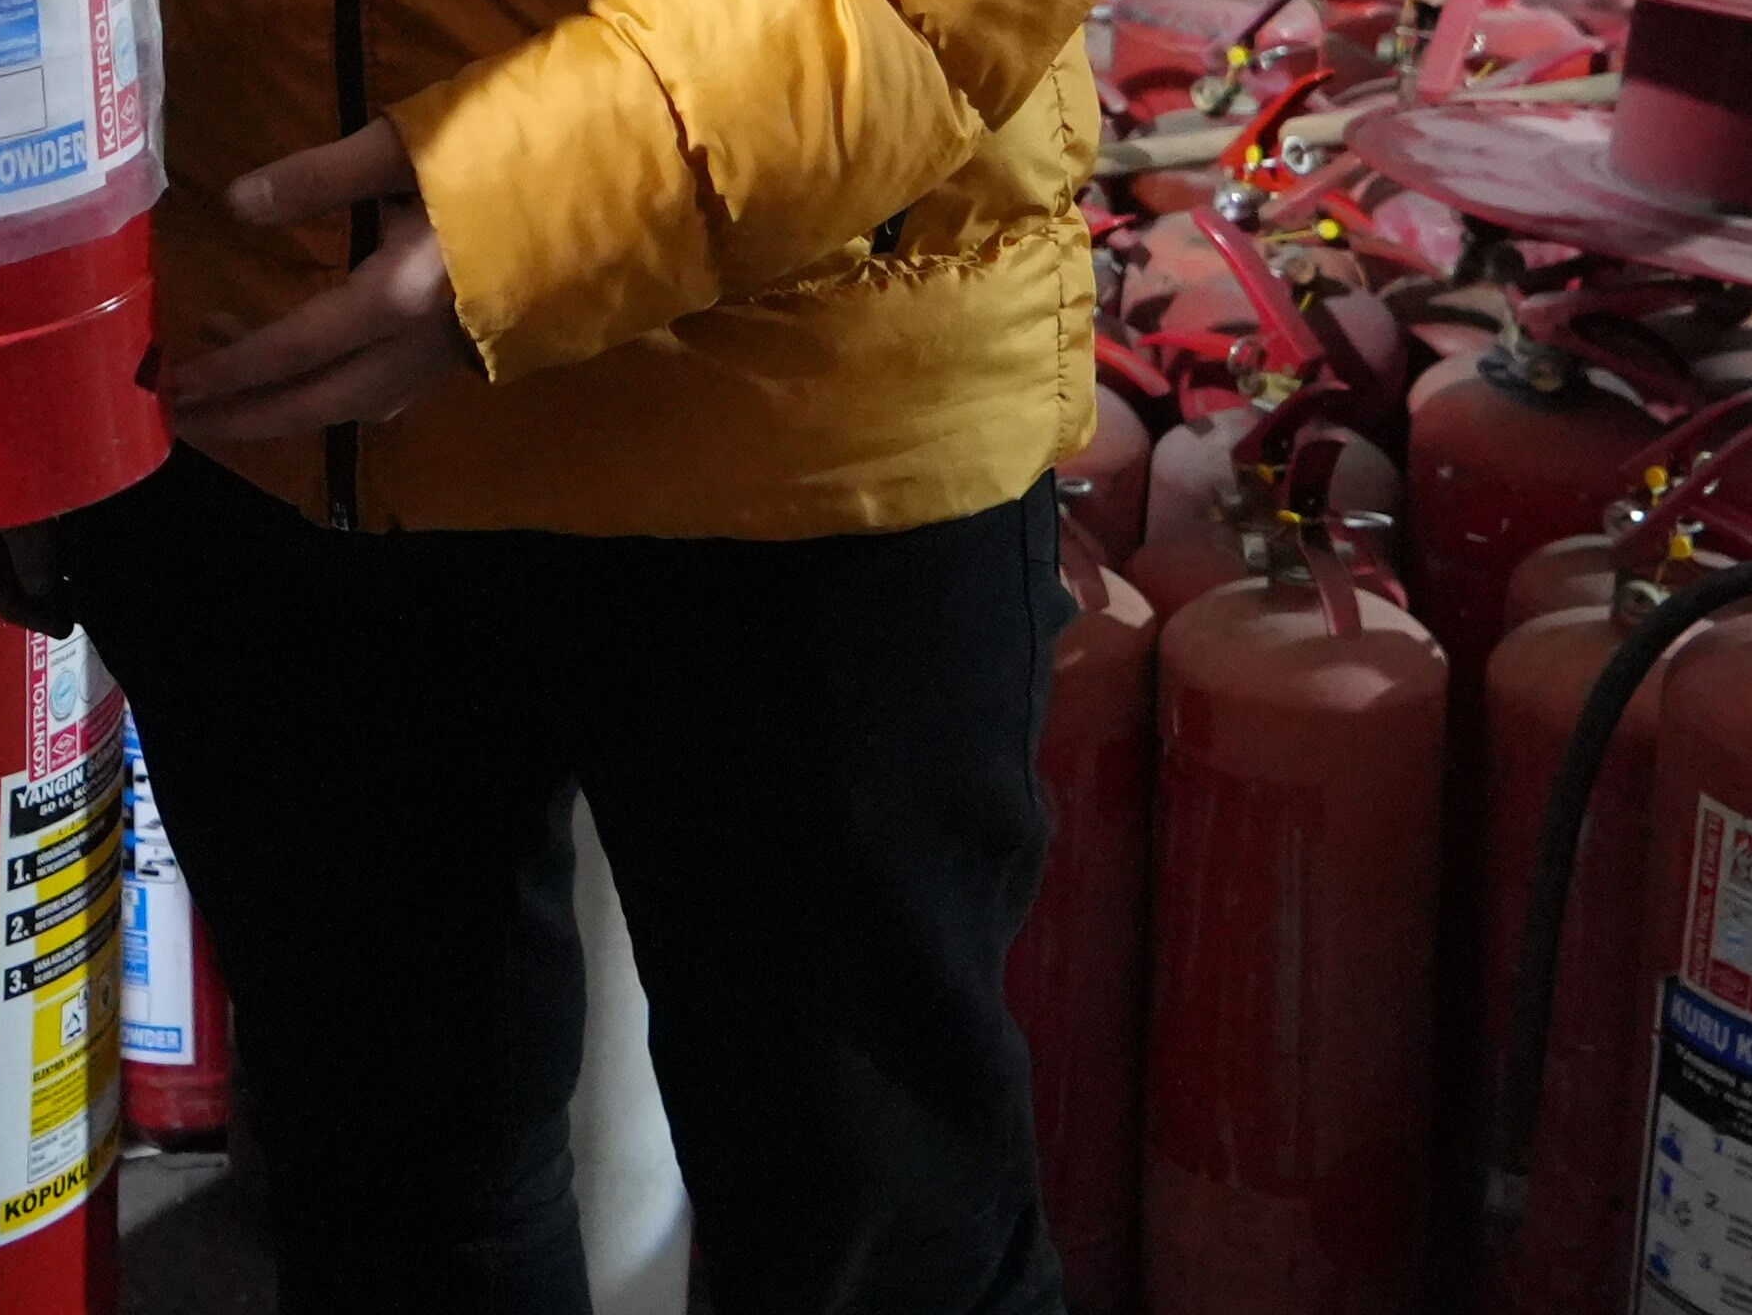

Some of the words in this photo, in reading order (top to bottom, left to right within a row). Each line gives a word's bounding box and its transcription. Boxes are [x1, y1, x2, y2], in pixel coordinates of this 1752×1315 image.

[93, 0, 117, 152] KONTROL
[33, 672, 47, 778] KONTROL
[16, 764, 86, 810] YANGIN
[13, 861, 31, 885] 1.
[10, 915, 30, 942] 2.
[8, 969, 28, 994] 3.
[1669, 994, 1730, 1053] KURU
